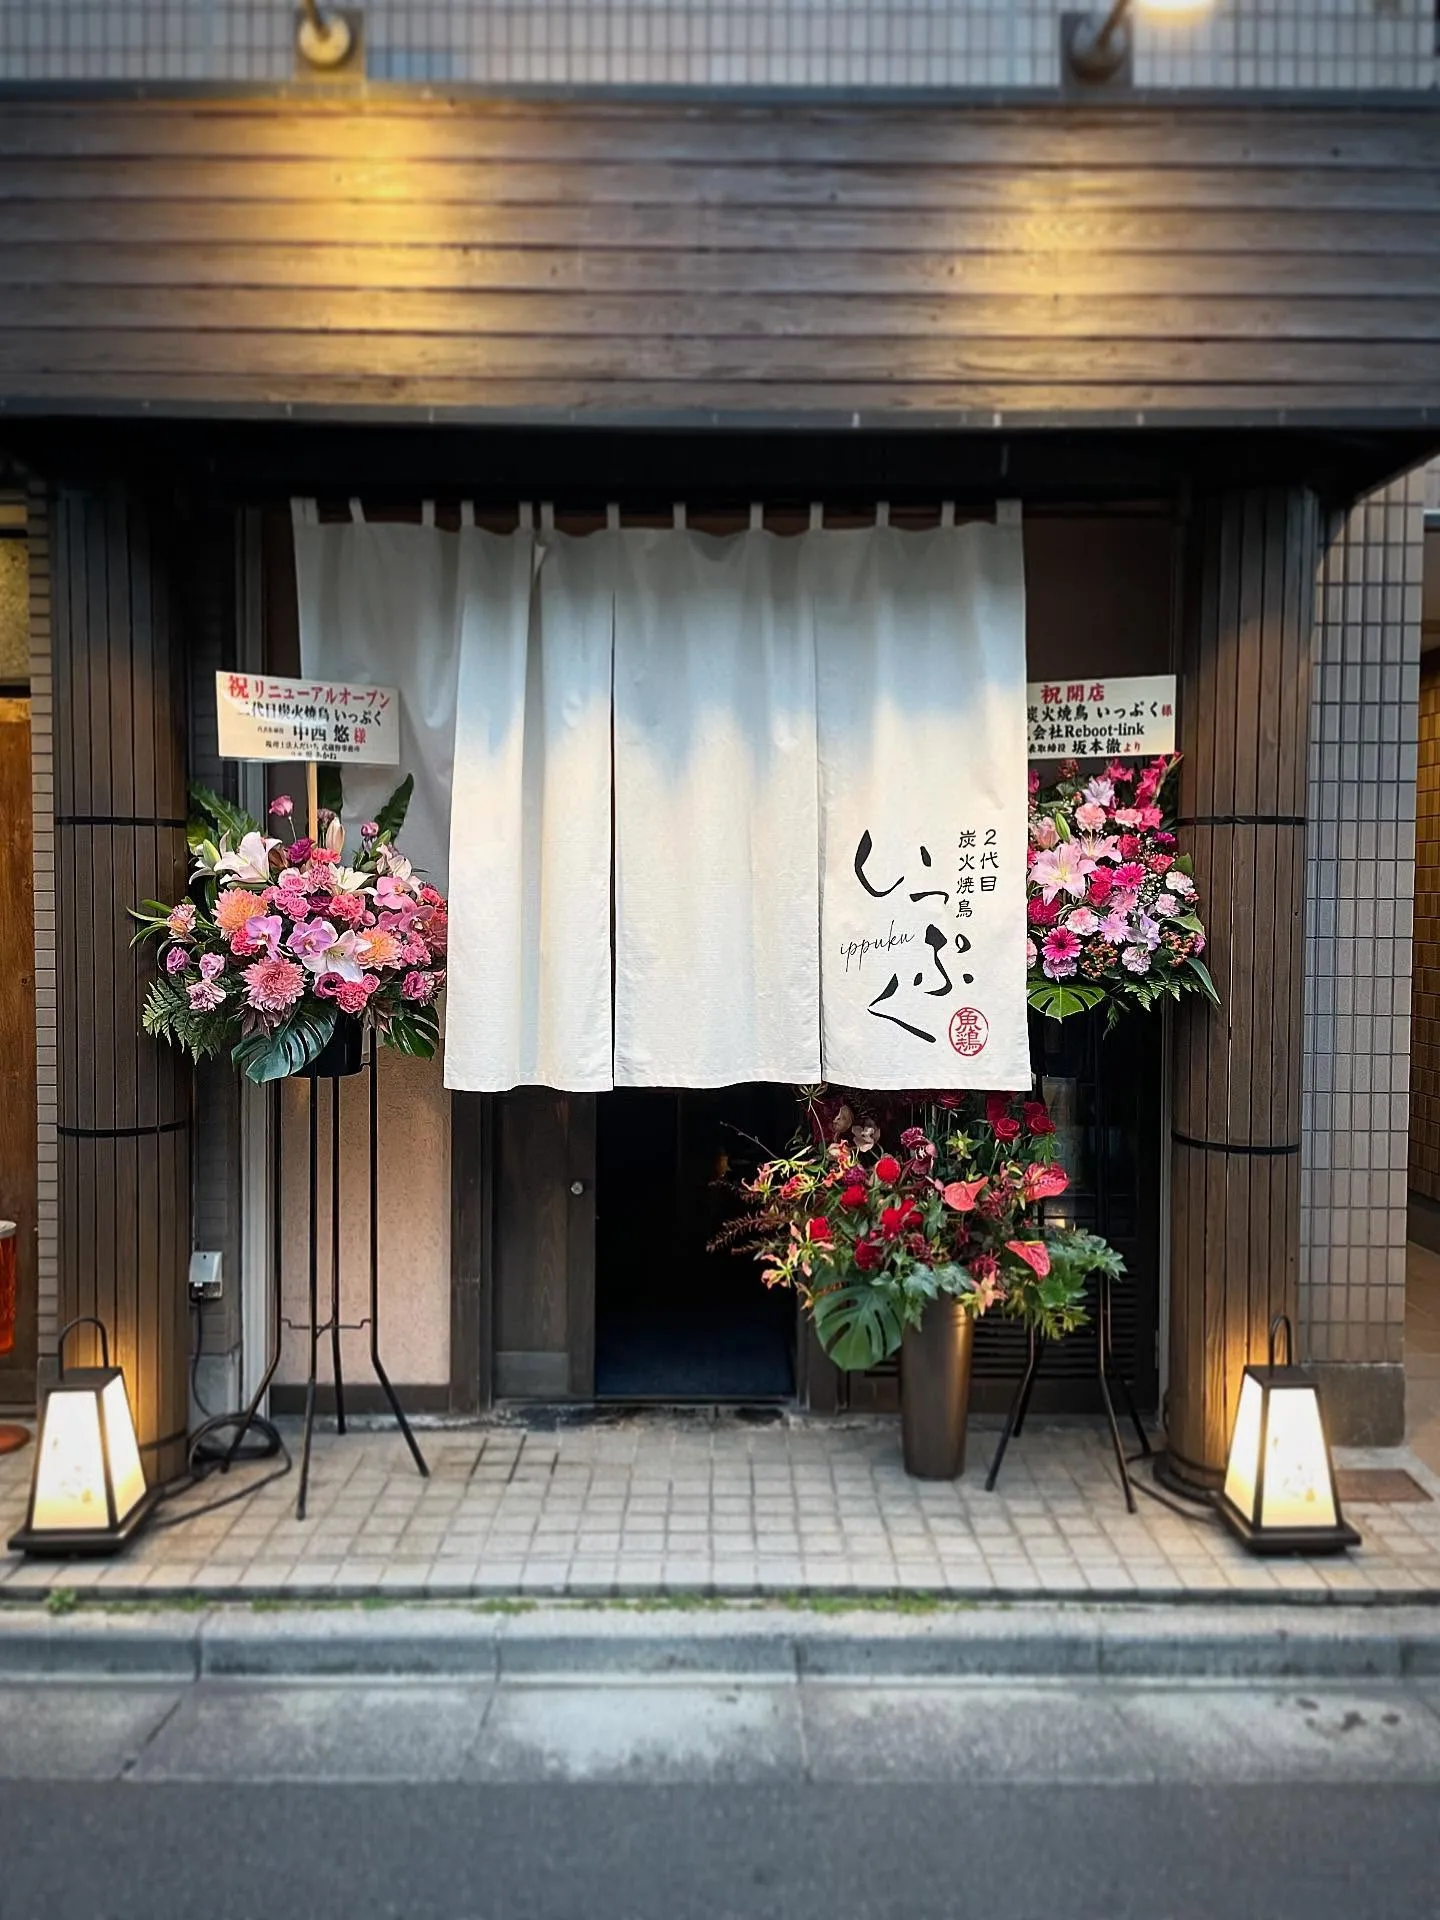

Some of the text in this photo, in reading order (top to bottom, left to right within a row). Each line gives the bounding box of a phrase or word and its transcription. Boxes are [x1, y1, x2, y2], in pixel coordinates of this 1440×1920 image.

[1040, 683, 1105, 705] 祝開店
[1027, 722, 1145, 741] 会社Reboot-link
[955, 830, 977, 918] 炭火焼鳥
[980, 829, 1000, 892] 2代目
[840, 920, 915, 972] ippuku
[854, 829, 975, 1044] いっぷく
